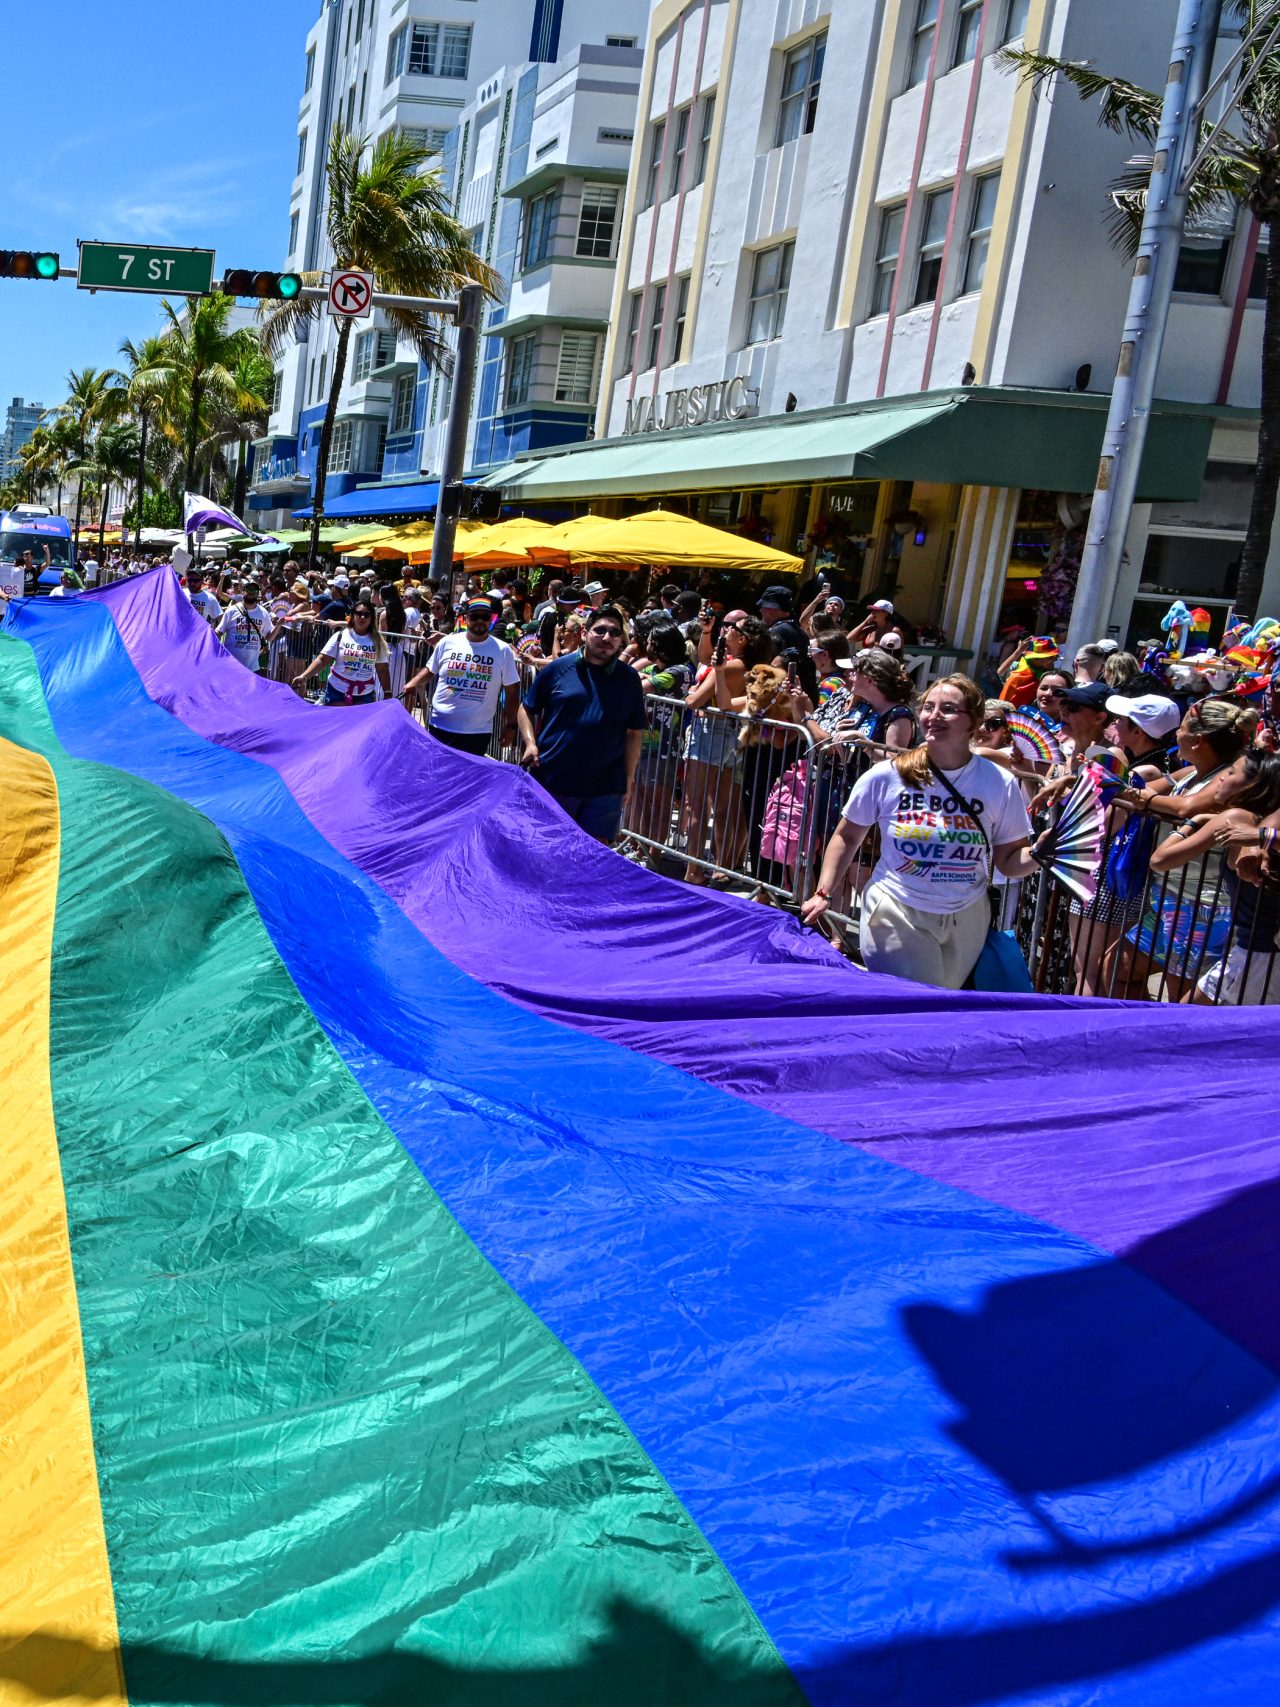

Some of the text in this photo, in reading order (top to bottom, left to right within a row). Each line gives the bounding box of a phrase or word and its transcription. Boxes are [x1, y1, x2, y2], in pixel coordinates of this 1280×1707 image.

[118, 254, 176, 280] 7 ST
[622, 376, 751, 436] MAJESTIC
[450, 652, 494, 666] BE BOLD
[447, 660, 493, 675] LIVE FREE
[446, 677, 488, 690] LOVE ALL
[466, 671, 493, 682] WOKE
[898, 793, 925, 811] BE
[897, 811, 937, 828] LIVE
[895, 825, 933, 841] STAY
[893, 838, 982, 861] LOVE ALL
